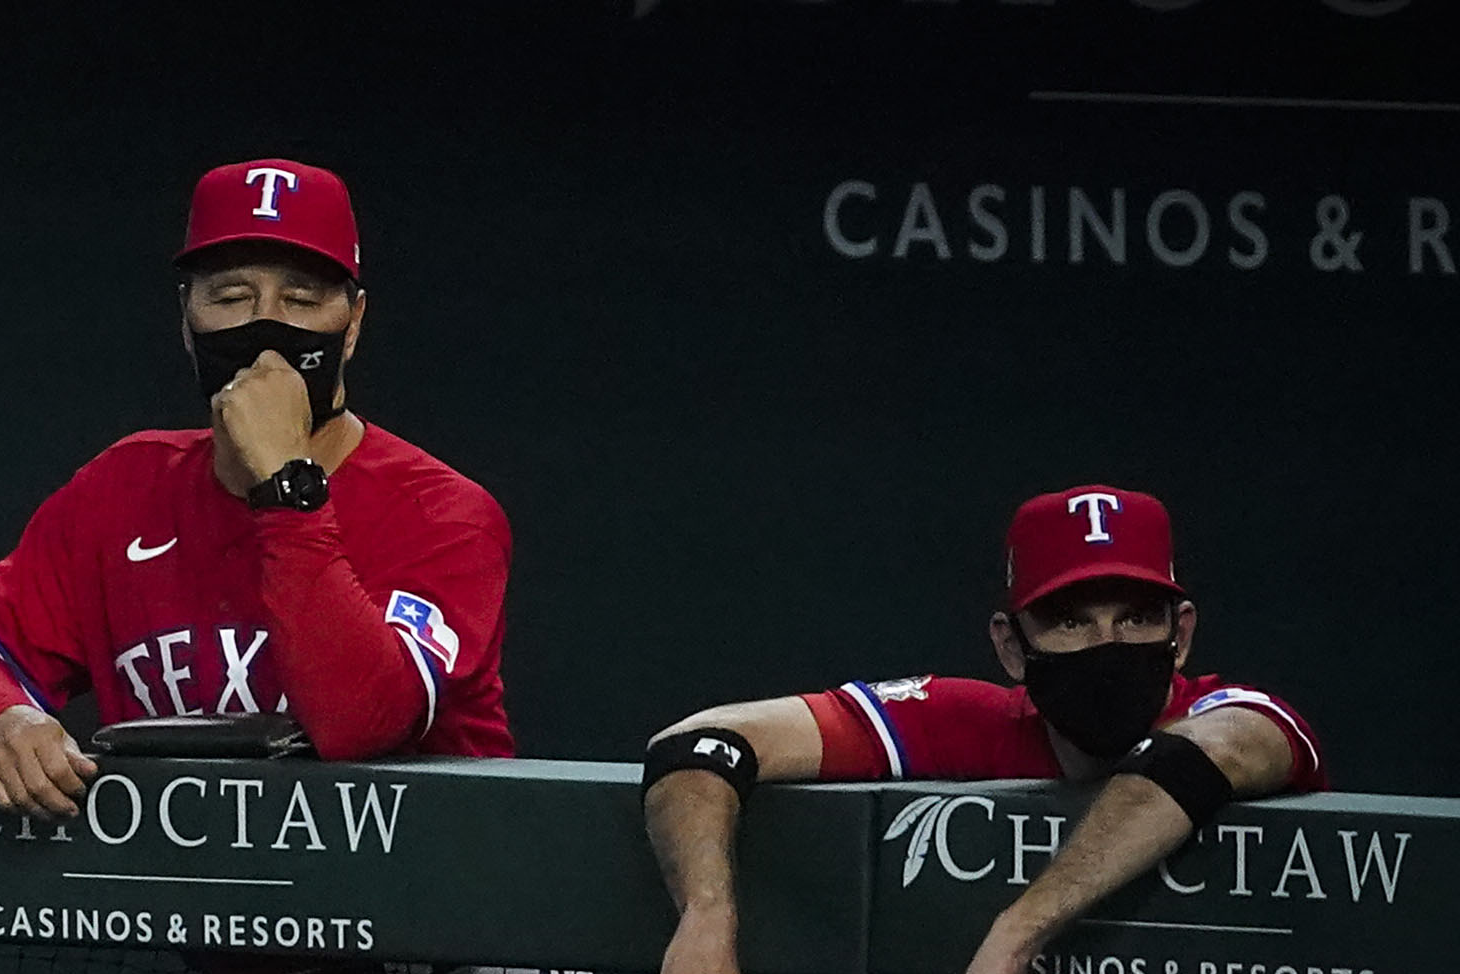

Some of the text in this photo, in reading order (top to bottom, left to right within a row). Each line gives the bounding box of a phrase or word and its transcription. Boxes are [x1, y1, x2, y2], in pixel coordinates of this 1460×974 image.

[246, 167, 298, 219] T
[822, 180, 1457, 274] CASINOS & R
[300, 350, 324, 370] 25
[1067, 492, 1122, 544] T
[115, 628, 289, 716] TEX
[937, 796, 1411, 903] CHTAW
[166, 913, 187, 944] &
[202, 914, 374, 950] RESORTS
